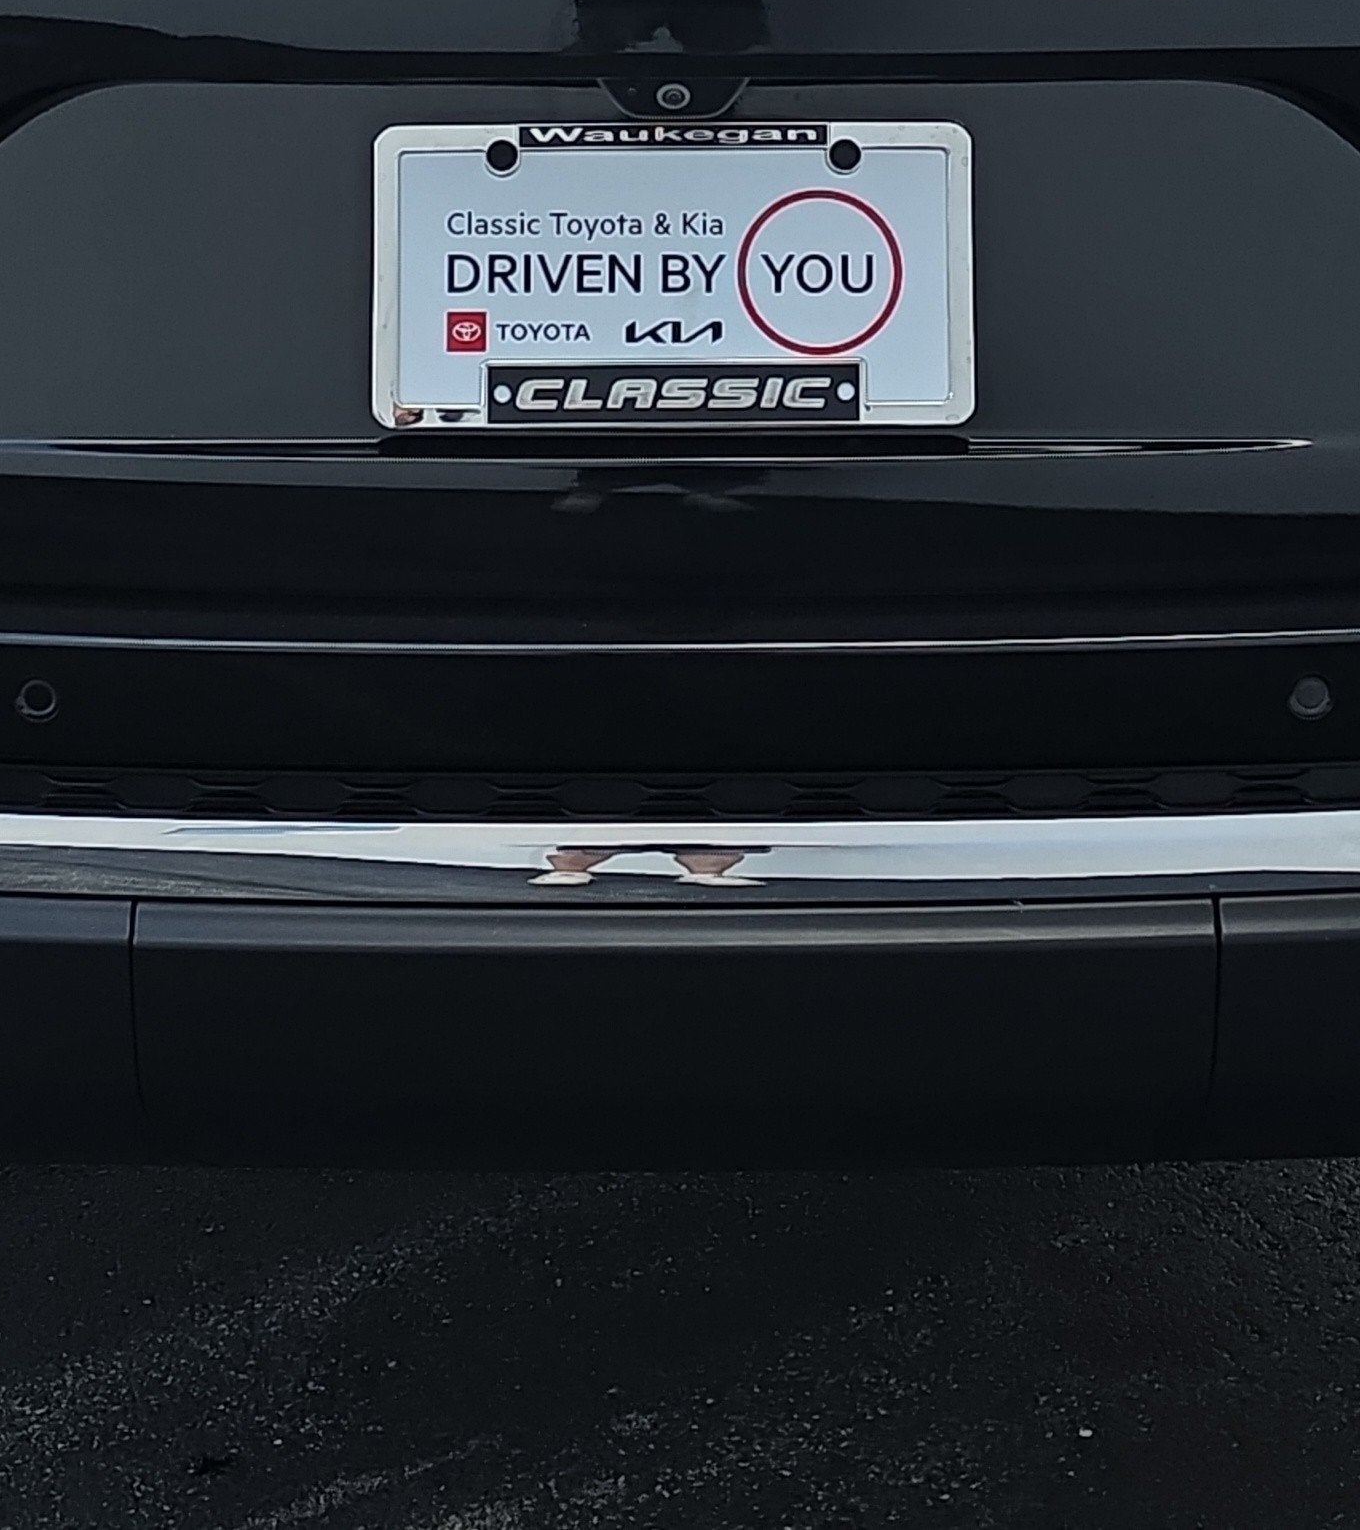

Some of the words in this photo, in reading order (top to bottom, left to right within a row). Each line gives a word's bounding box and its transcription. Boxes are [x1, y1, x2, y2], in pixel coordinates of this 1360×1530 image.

[529, 126, 818, 144] Waukegan
[446, 211, 541, 236] Classic
[549, 212, 643, 241] Toyota
[654, 212, 671, 236] &
[682, 211, 724, 236] Kia
[446, 254, 642, 294] DRIVEN
[661, 254, 727, 294] BY
[760, 254, 875, 294] YOU
[496, 323, 591, 342] TOYOTA
[515, 376, 832, 410] CLASSIC
